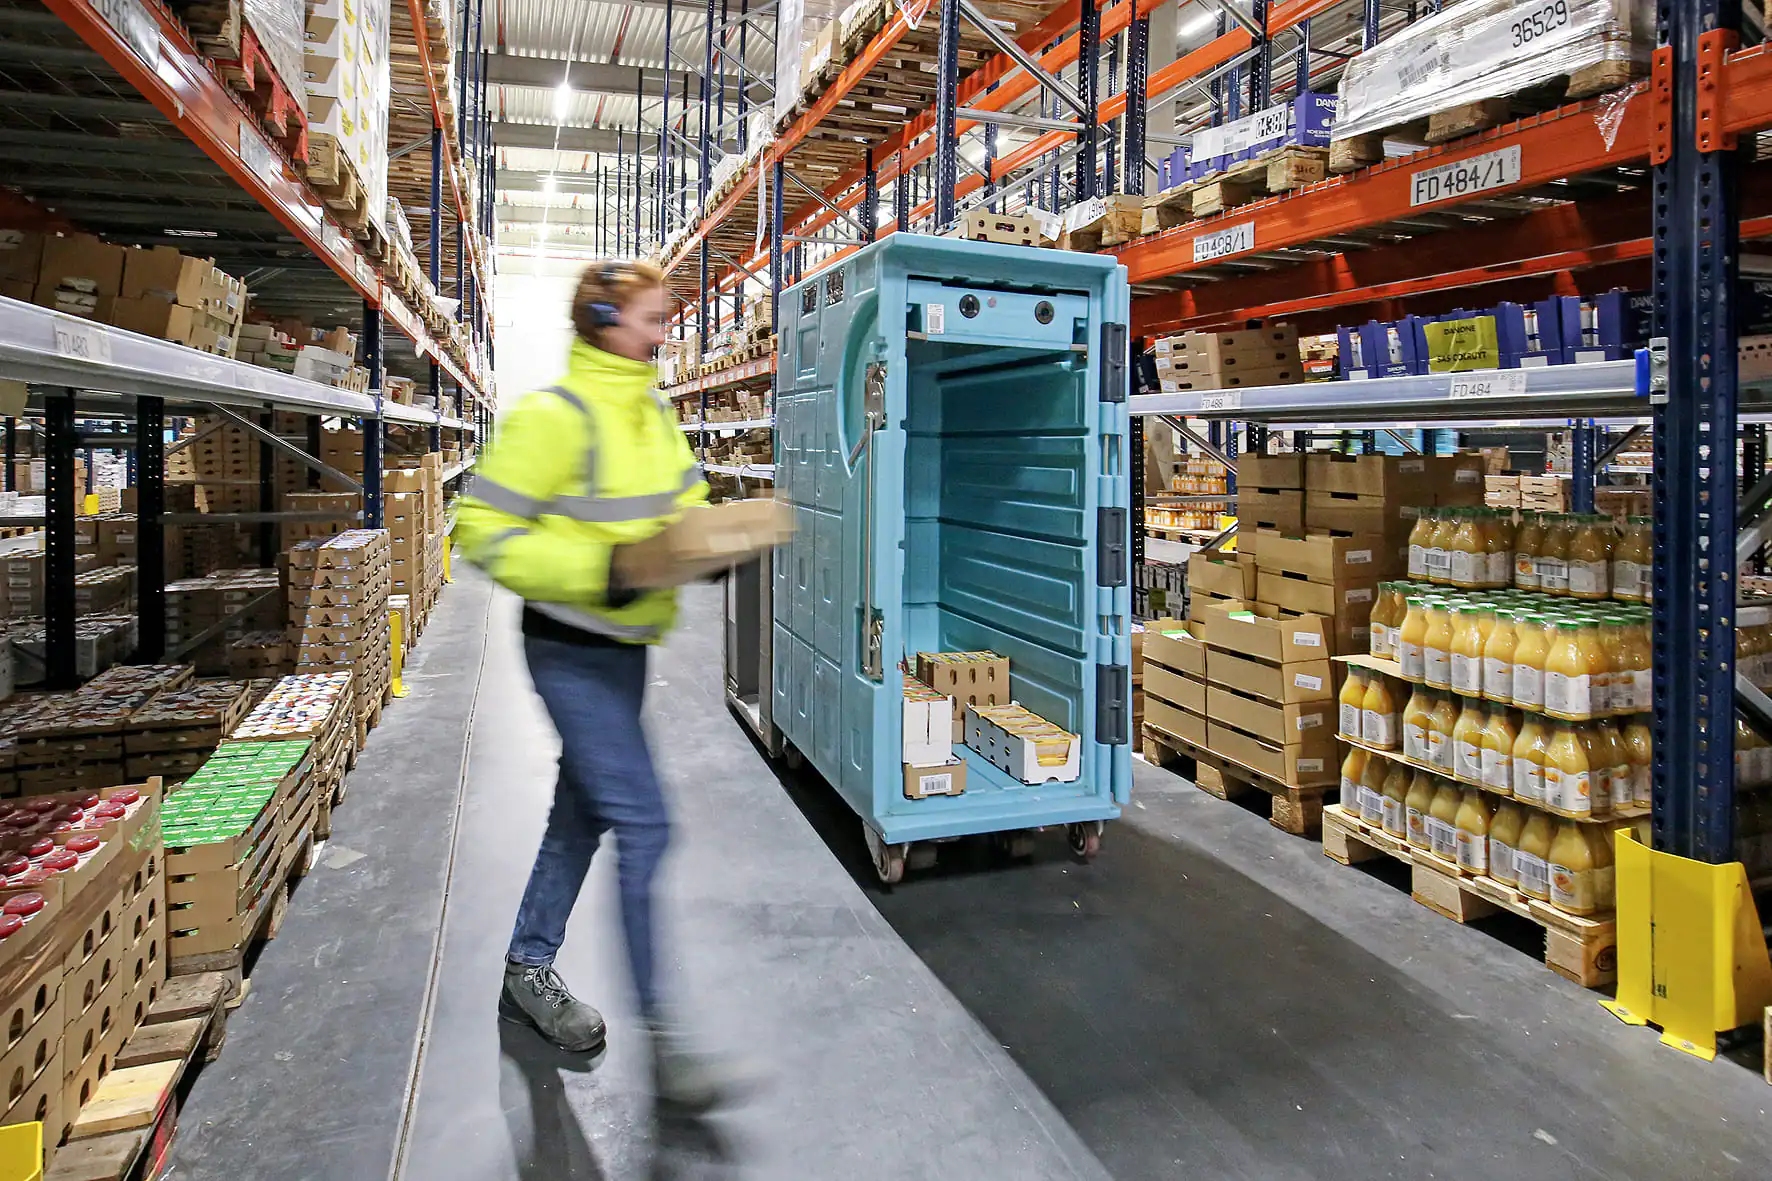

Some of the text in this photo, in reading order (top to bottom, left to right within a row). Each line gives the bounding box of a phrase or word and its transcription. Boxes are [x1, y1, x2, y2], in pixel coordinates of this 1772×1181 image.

[1510, 0, 1568, 49] 36529
[1416, 176, 1440, 204] FD
[1443, 158, 1505, 196] 484/1
[1443, 324, 1476, 336] DANONE
[1452, 383, 1491, 397] FD 484
